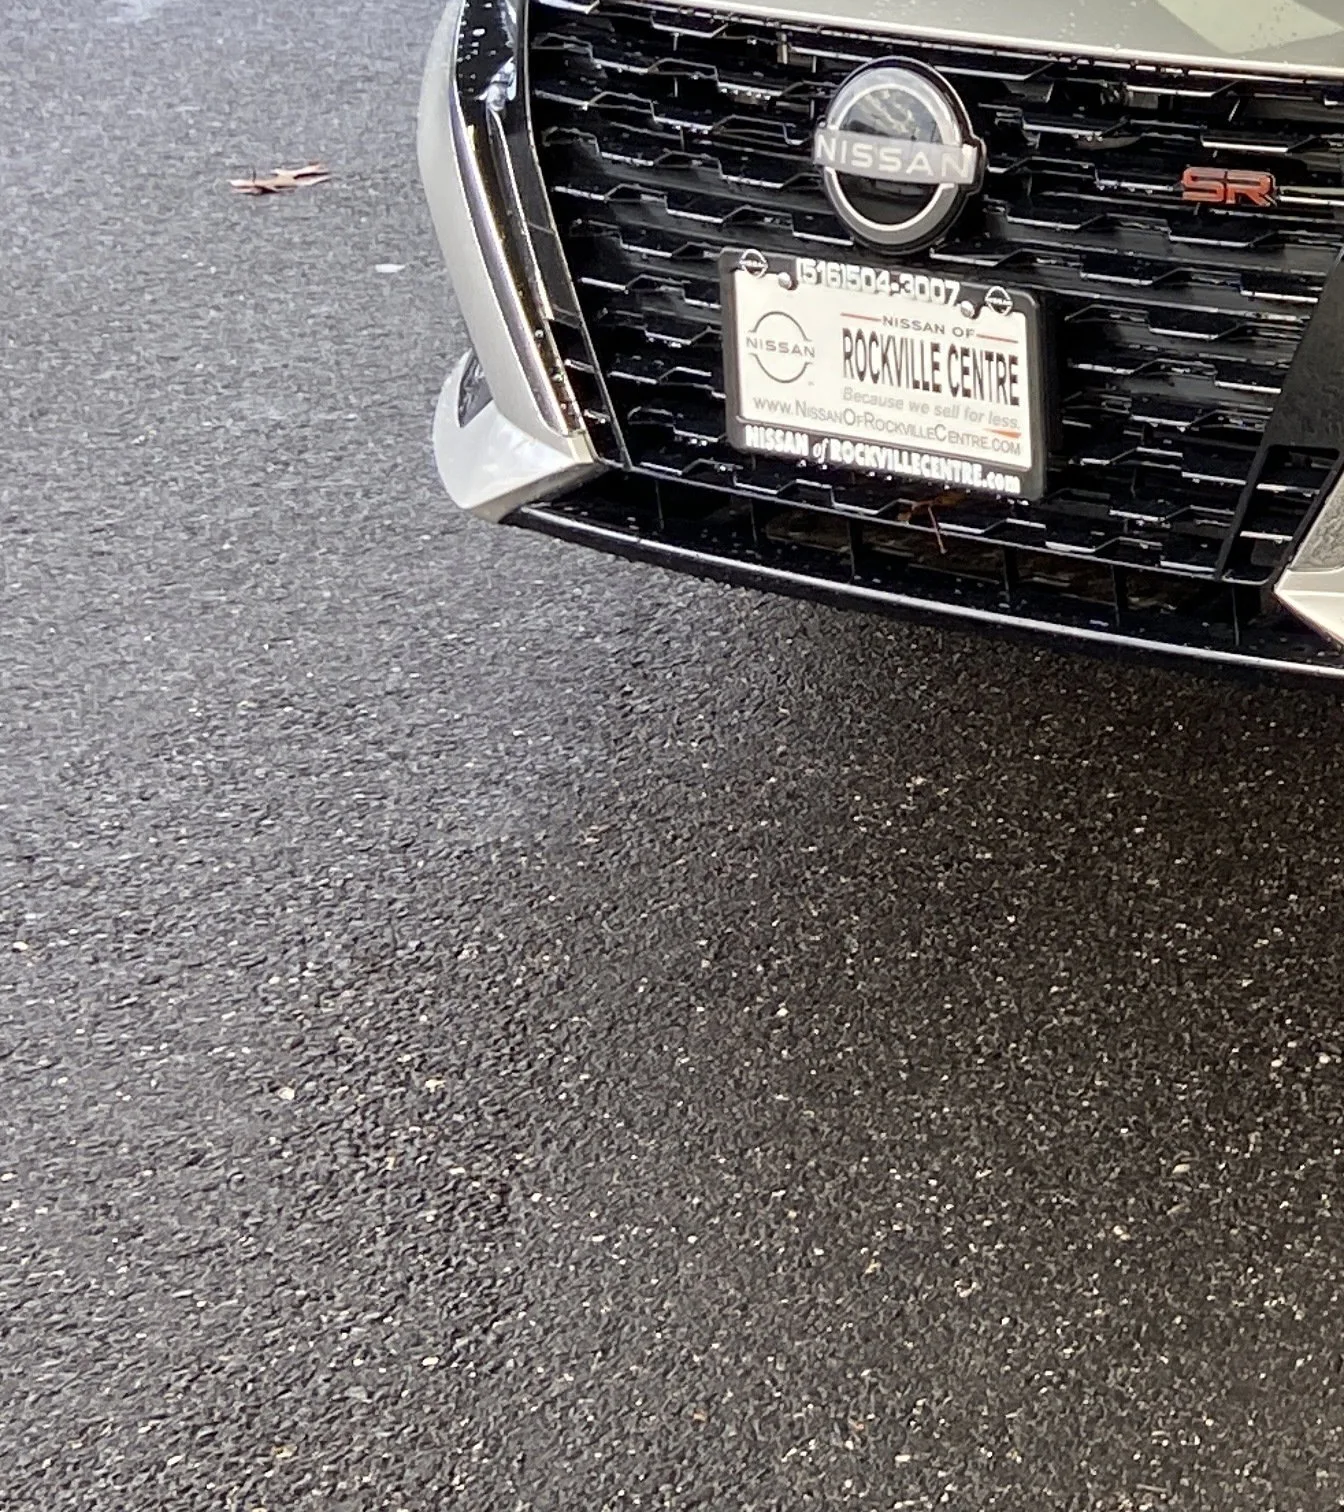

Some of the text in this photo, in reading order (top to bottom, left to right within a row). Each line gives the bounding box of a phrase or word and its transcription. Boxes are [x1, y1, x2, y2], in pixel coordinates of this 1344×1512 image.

[815, 134, 972, 178] NISSAN
[1182, 166, 1272, 207] SR
[745, 336, 816, 358] NISSAN
[882, 315, 976, 339] NISSAN OF
[841, 327, 1020, 406] ROCKVILLE CENTRE
[842, 386, 1021, 429] Because we sell for less.
[745, 425, 809, 457] NISSAN
[812, 438, 829, 464] of
